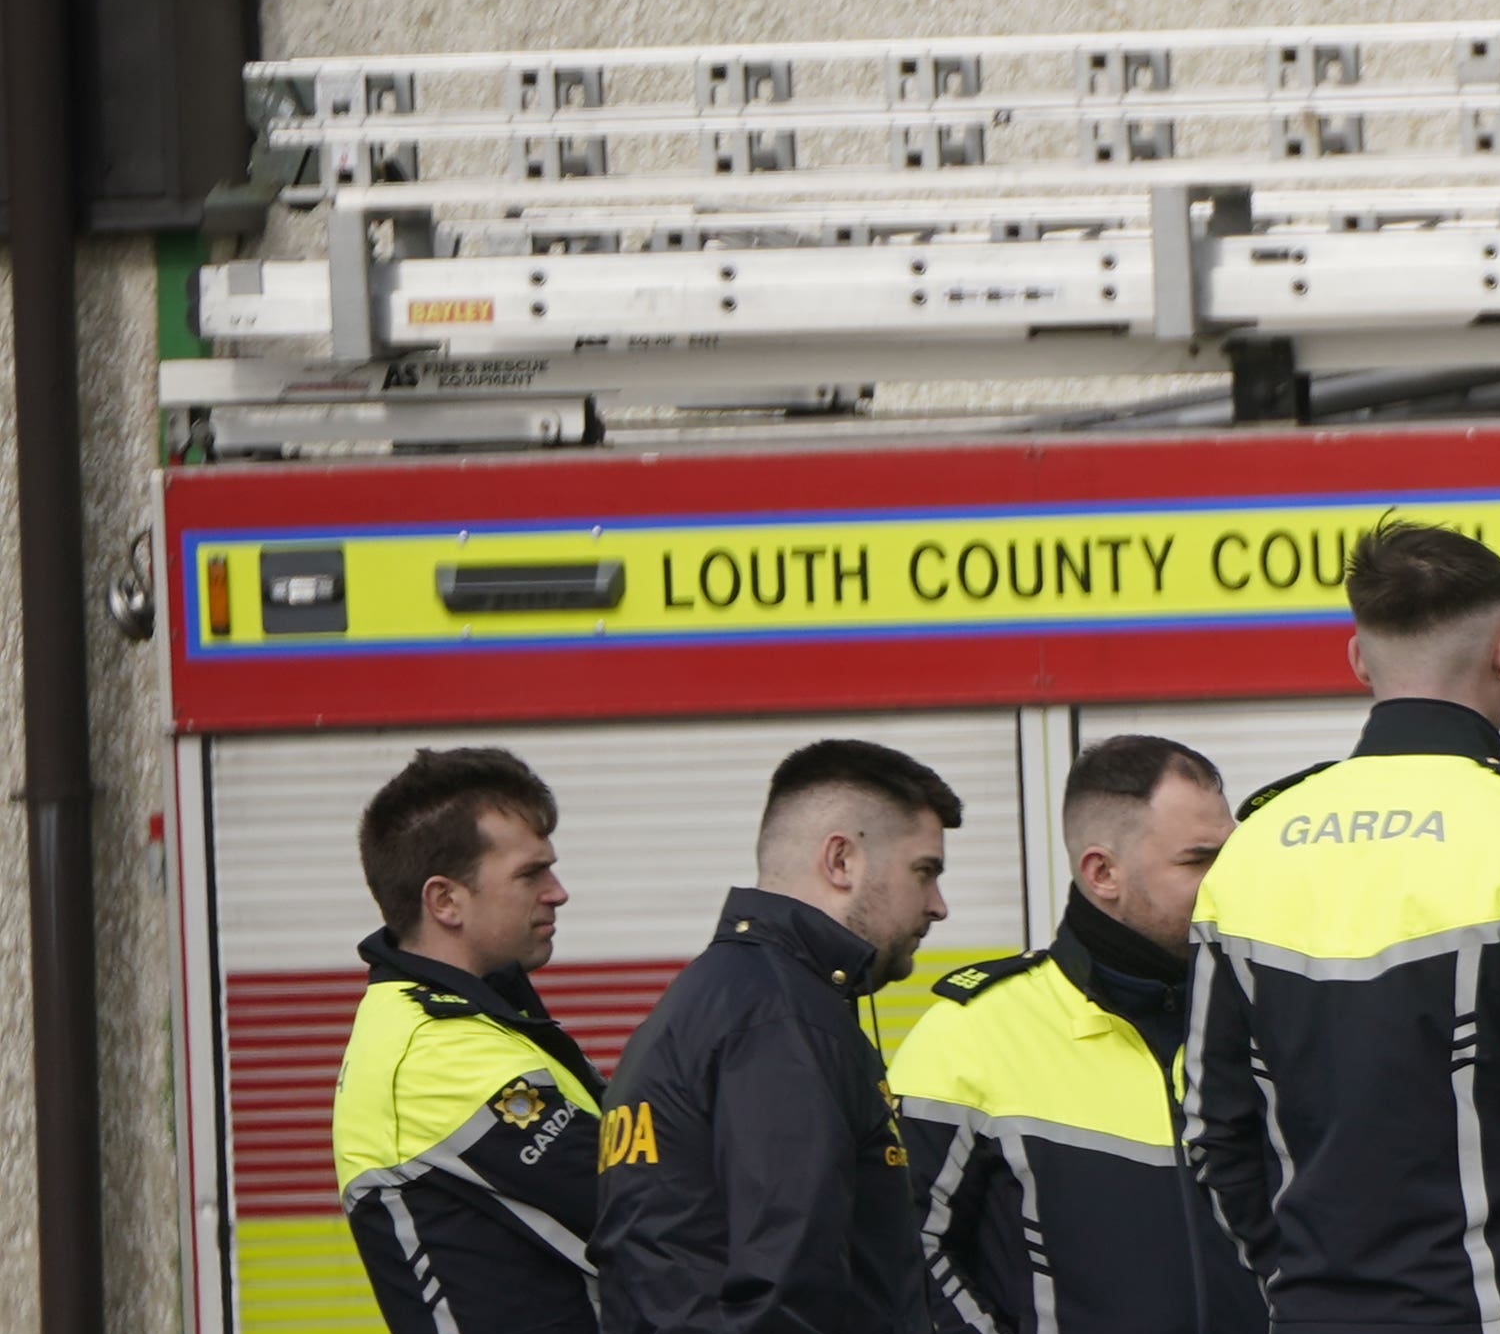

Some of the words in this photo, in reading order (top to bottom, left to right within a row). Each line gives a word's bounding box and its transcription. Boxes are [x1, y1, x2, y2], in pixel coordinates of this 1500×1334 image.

[411, 299, 491, 323] BAYLEY
[663, 544, 869, 610] LOUTH
[909, 535, 1175, 602] COUNTY
[1280, 810, 1446, 847] GARDA
[519, 1099, 580, 1166] GARDA
